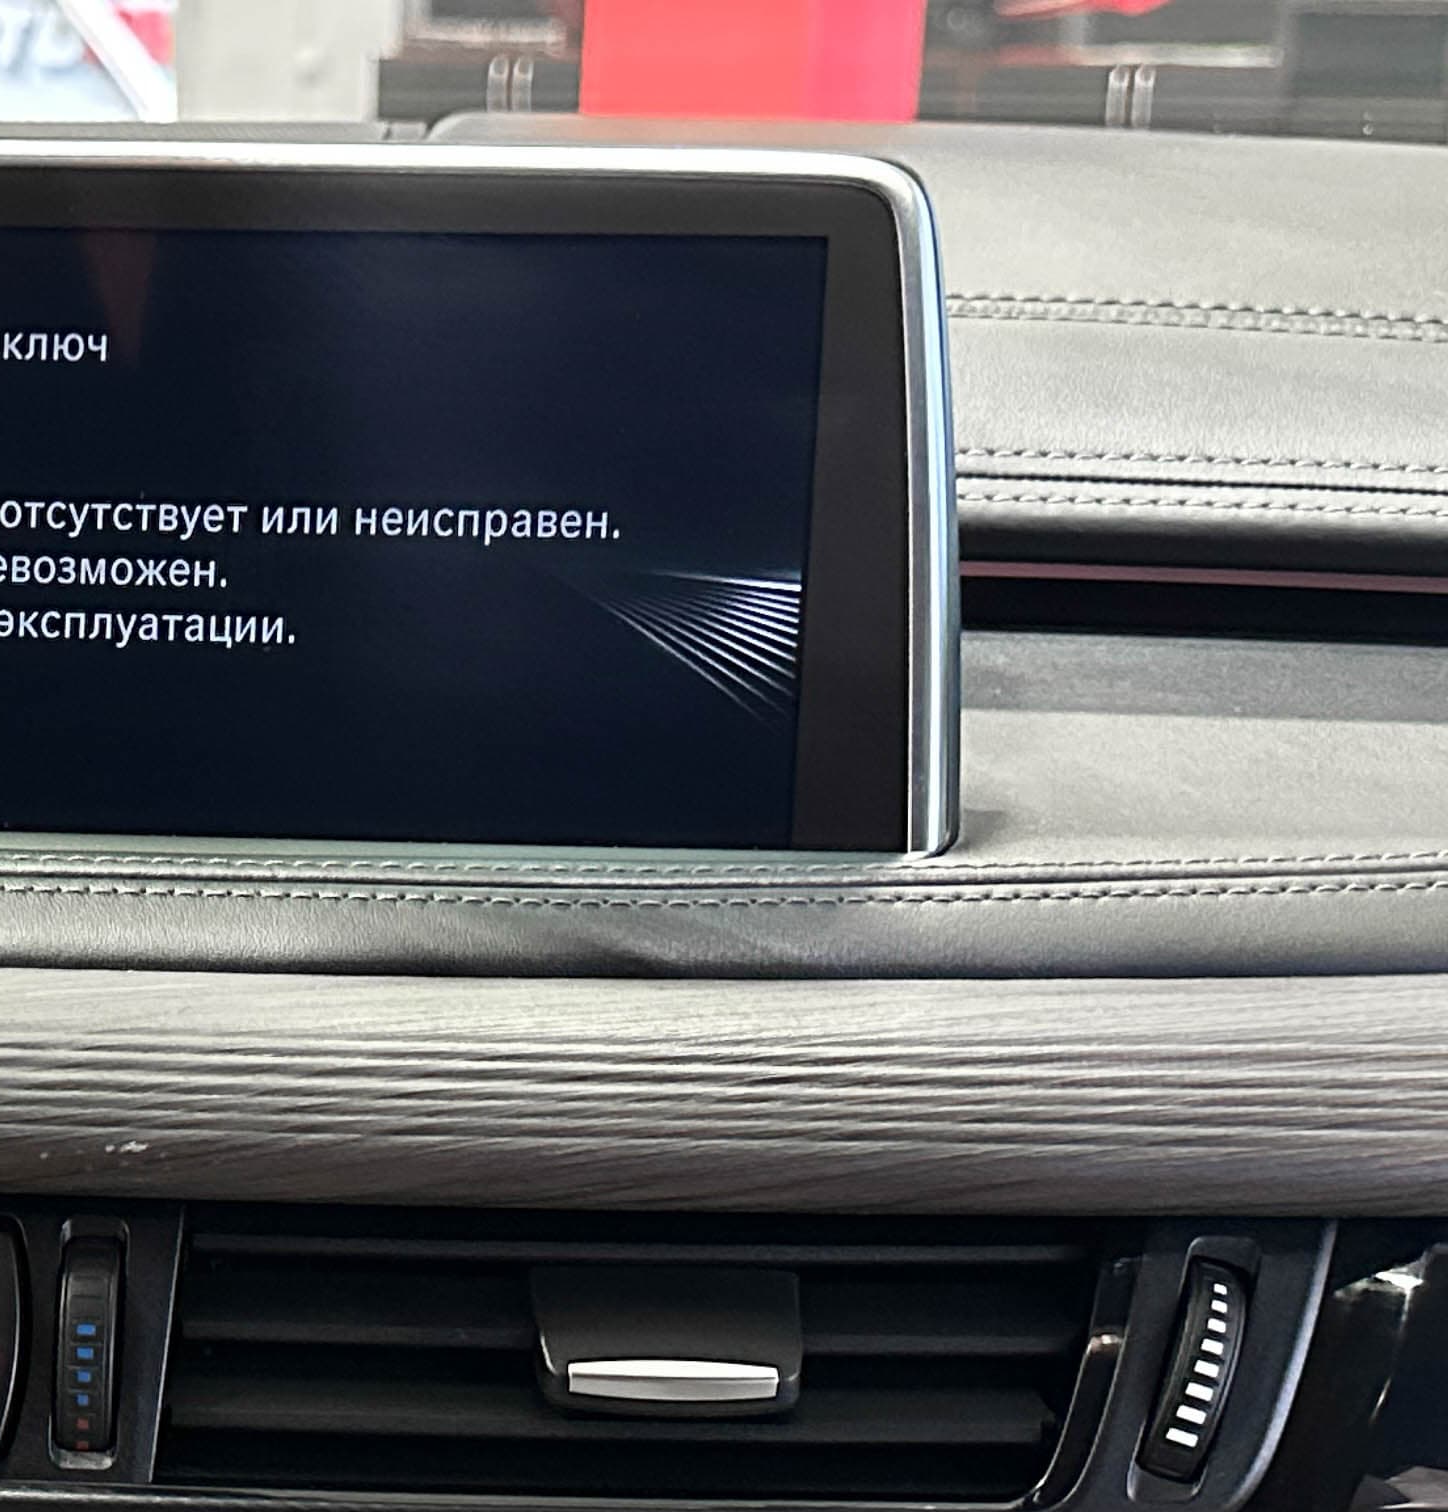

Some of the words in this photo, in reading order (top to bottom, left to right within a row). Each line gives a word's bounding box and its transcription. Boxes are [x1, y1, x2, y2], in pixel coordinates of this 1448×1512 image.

[2, 332, 108, 362] ключ
[0, 500, 248, 541] отсутствует
[261, 506, 338, 535] или
[355, 507, 620, 547] неисправен.
